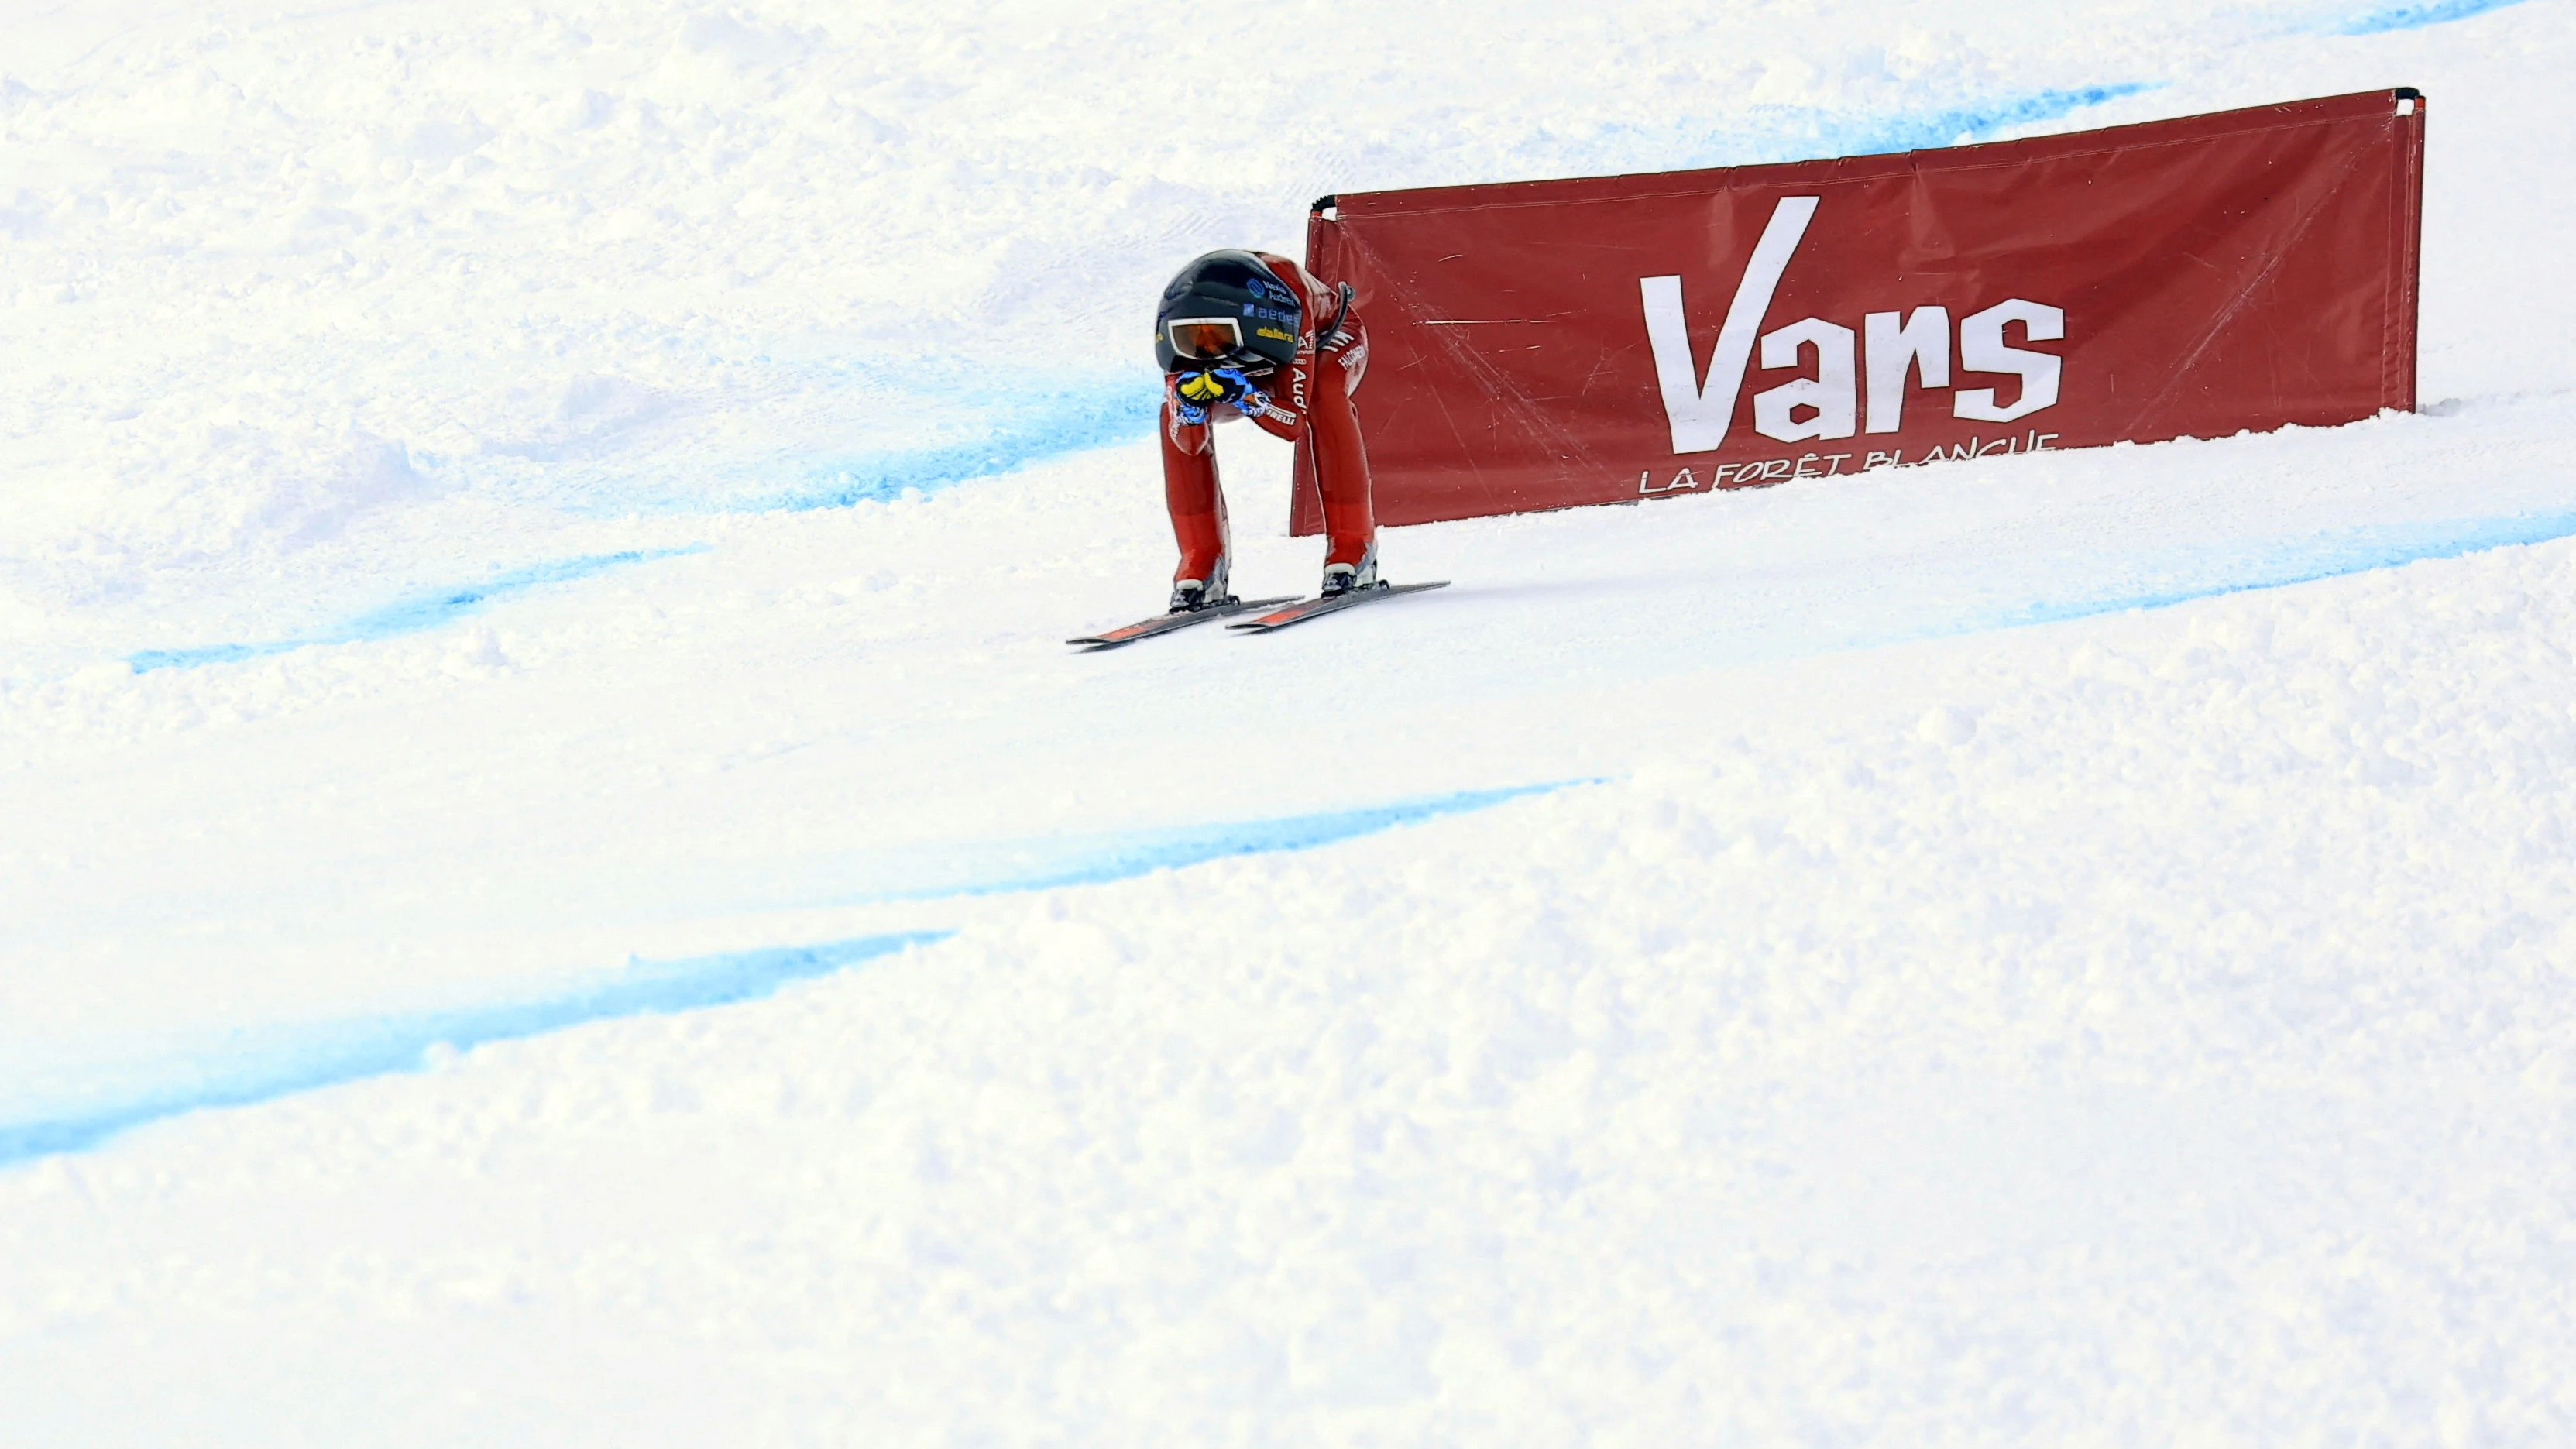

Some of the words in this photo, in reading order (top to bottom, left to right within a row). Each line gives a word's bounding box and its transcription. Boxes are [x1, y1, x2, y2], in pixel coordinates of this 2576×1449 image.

[1640, 195, 2065, 454] Vars
[1638, 467, 1698, 494] LA
[1711, 452, 1853, 489] FORÊT
